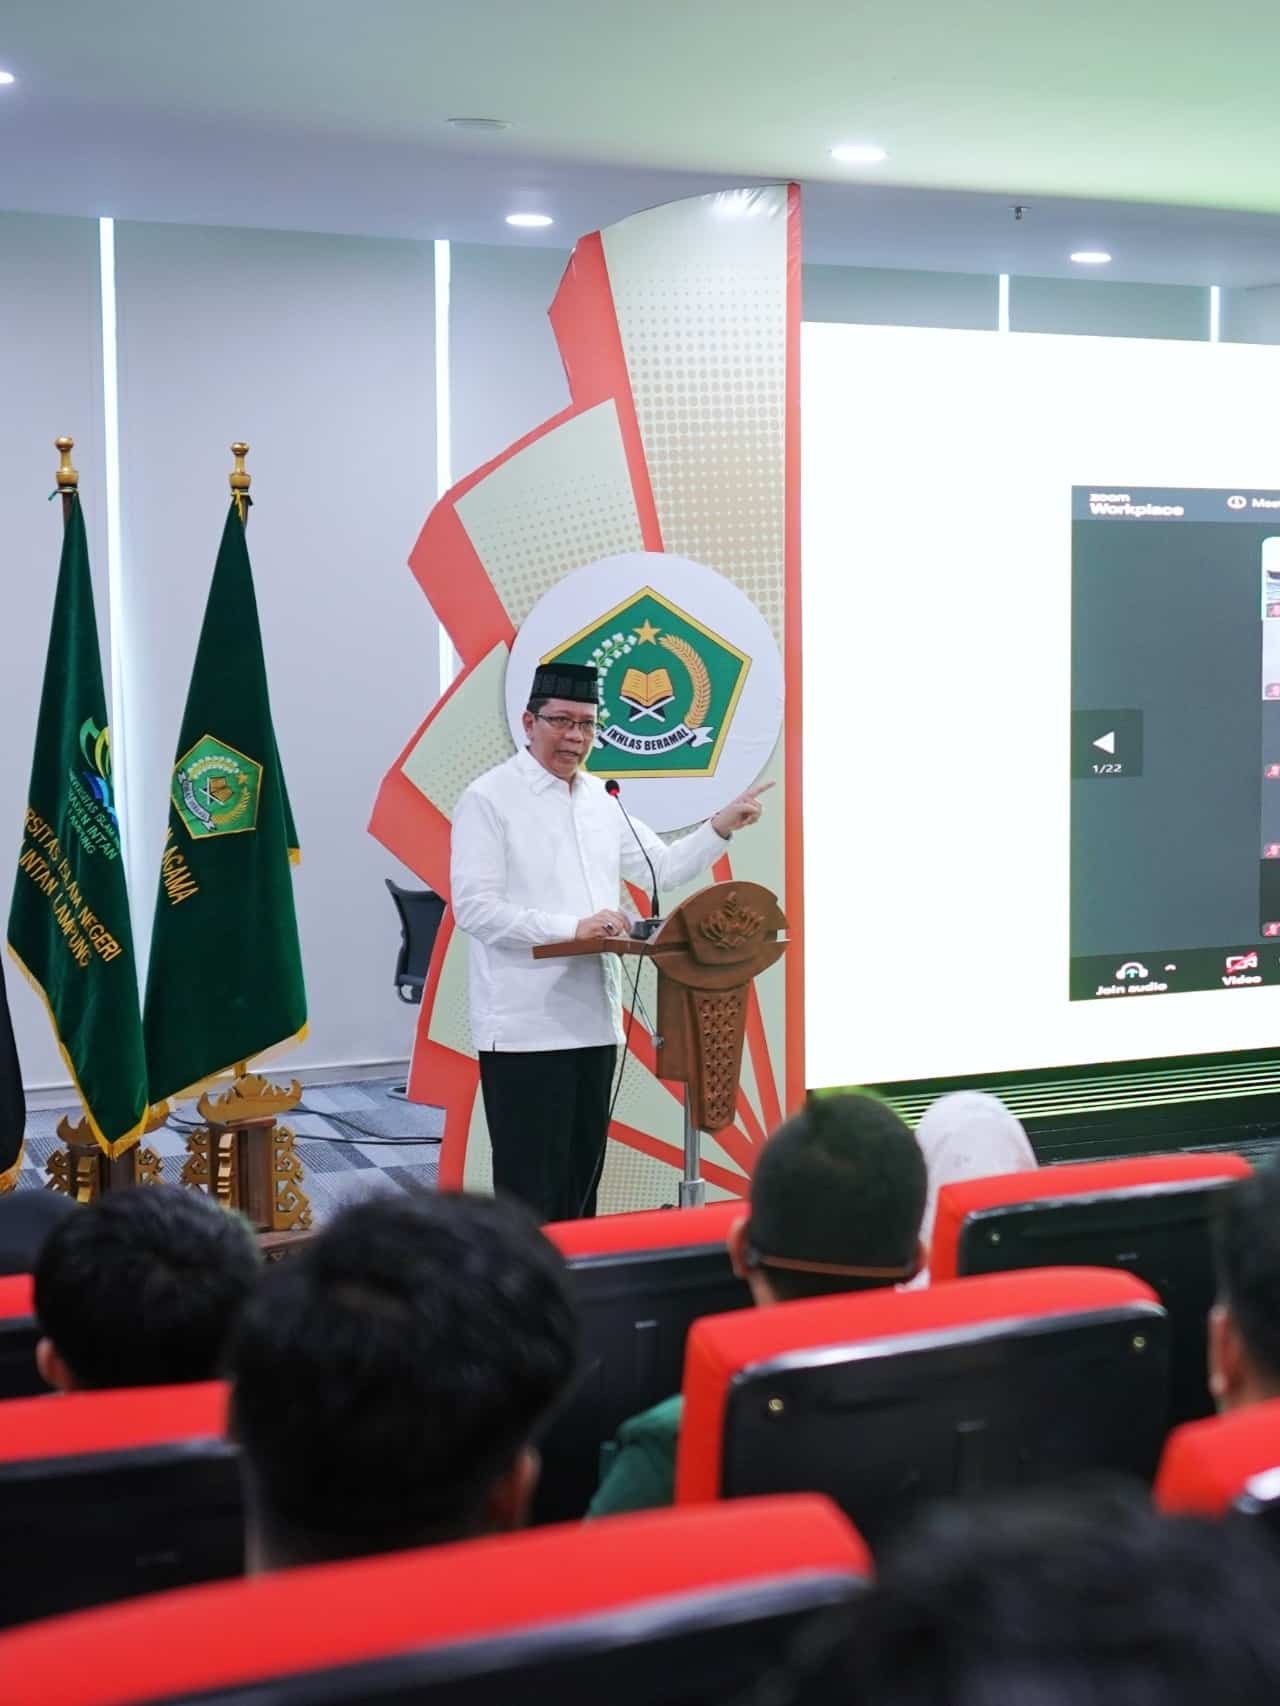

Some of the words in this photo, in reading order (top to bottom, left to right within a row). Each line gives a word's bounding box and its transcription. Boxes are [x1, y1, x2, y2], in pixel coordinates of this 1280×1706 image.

[1089, 502, 1185, 517] Workplace
[606, 728, 641, 750] IKHLAS
[644, 728, 690, 751] BERAMAL
[1092, 763, 1122, 774] 1/22
[86, 824, 118, 861] INTAN
[162, 845, 200, 905] AGAMA
[18, 847, 60, 897] INTAN
[52, 891, 93, 968] LAMPUNG
[57, 857, 85, 910] ISLAM
[77, 905, 123, 963] NEGERI
[1095, 984, 1125, 996] Join
[1127, 981, 1168, 994] audio
[1221, 973, 1262, 986] Video
